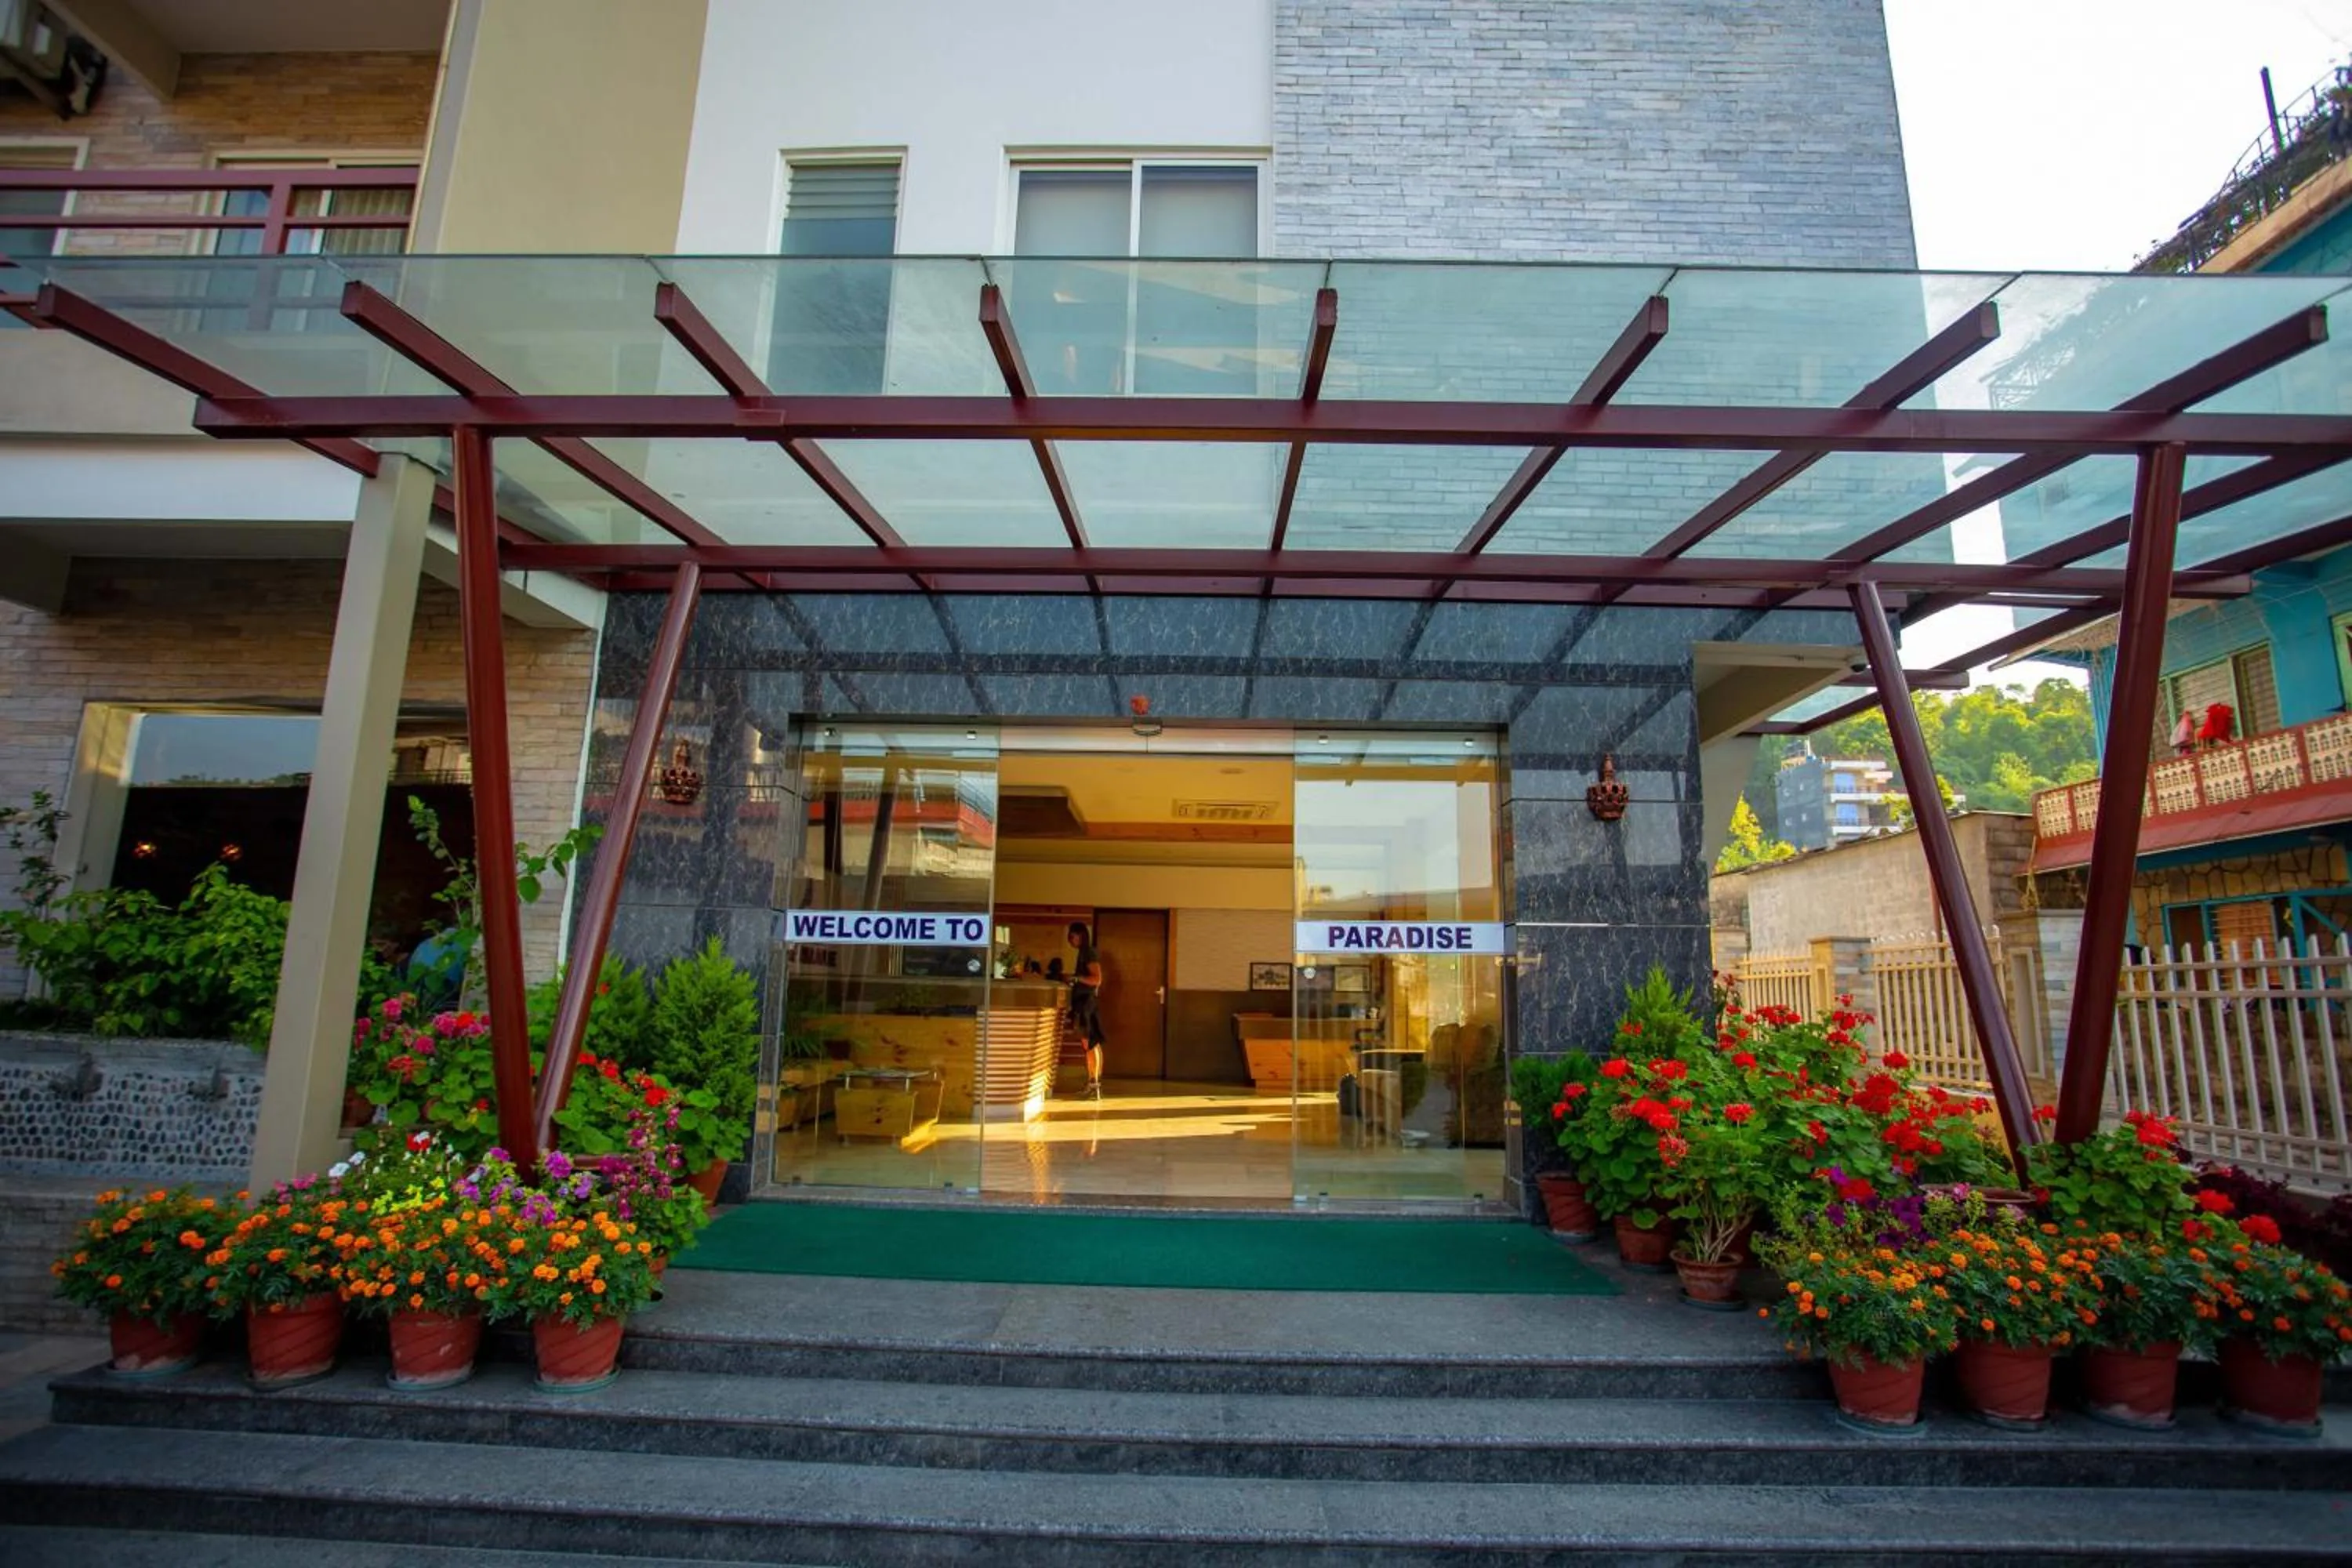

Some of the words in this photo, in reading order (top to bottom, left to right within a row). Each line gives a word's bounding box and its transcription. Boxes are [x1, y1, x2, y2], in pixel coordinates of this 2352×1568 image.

[793, 915, 935, 939] WELCOME
[946, 918, 984, 941] TO
[1328, 926, 1472, 949] PARADISE
